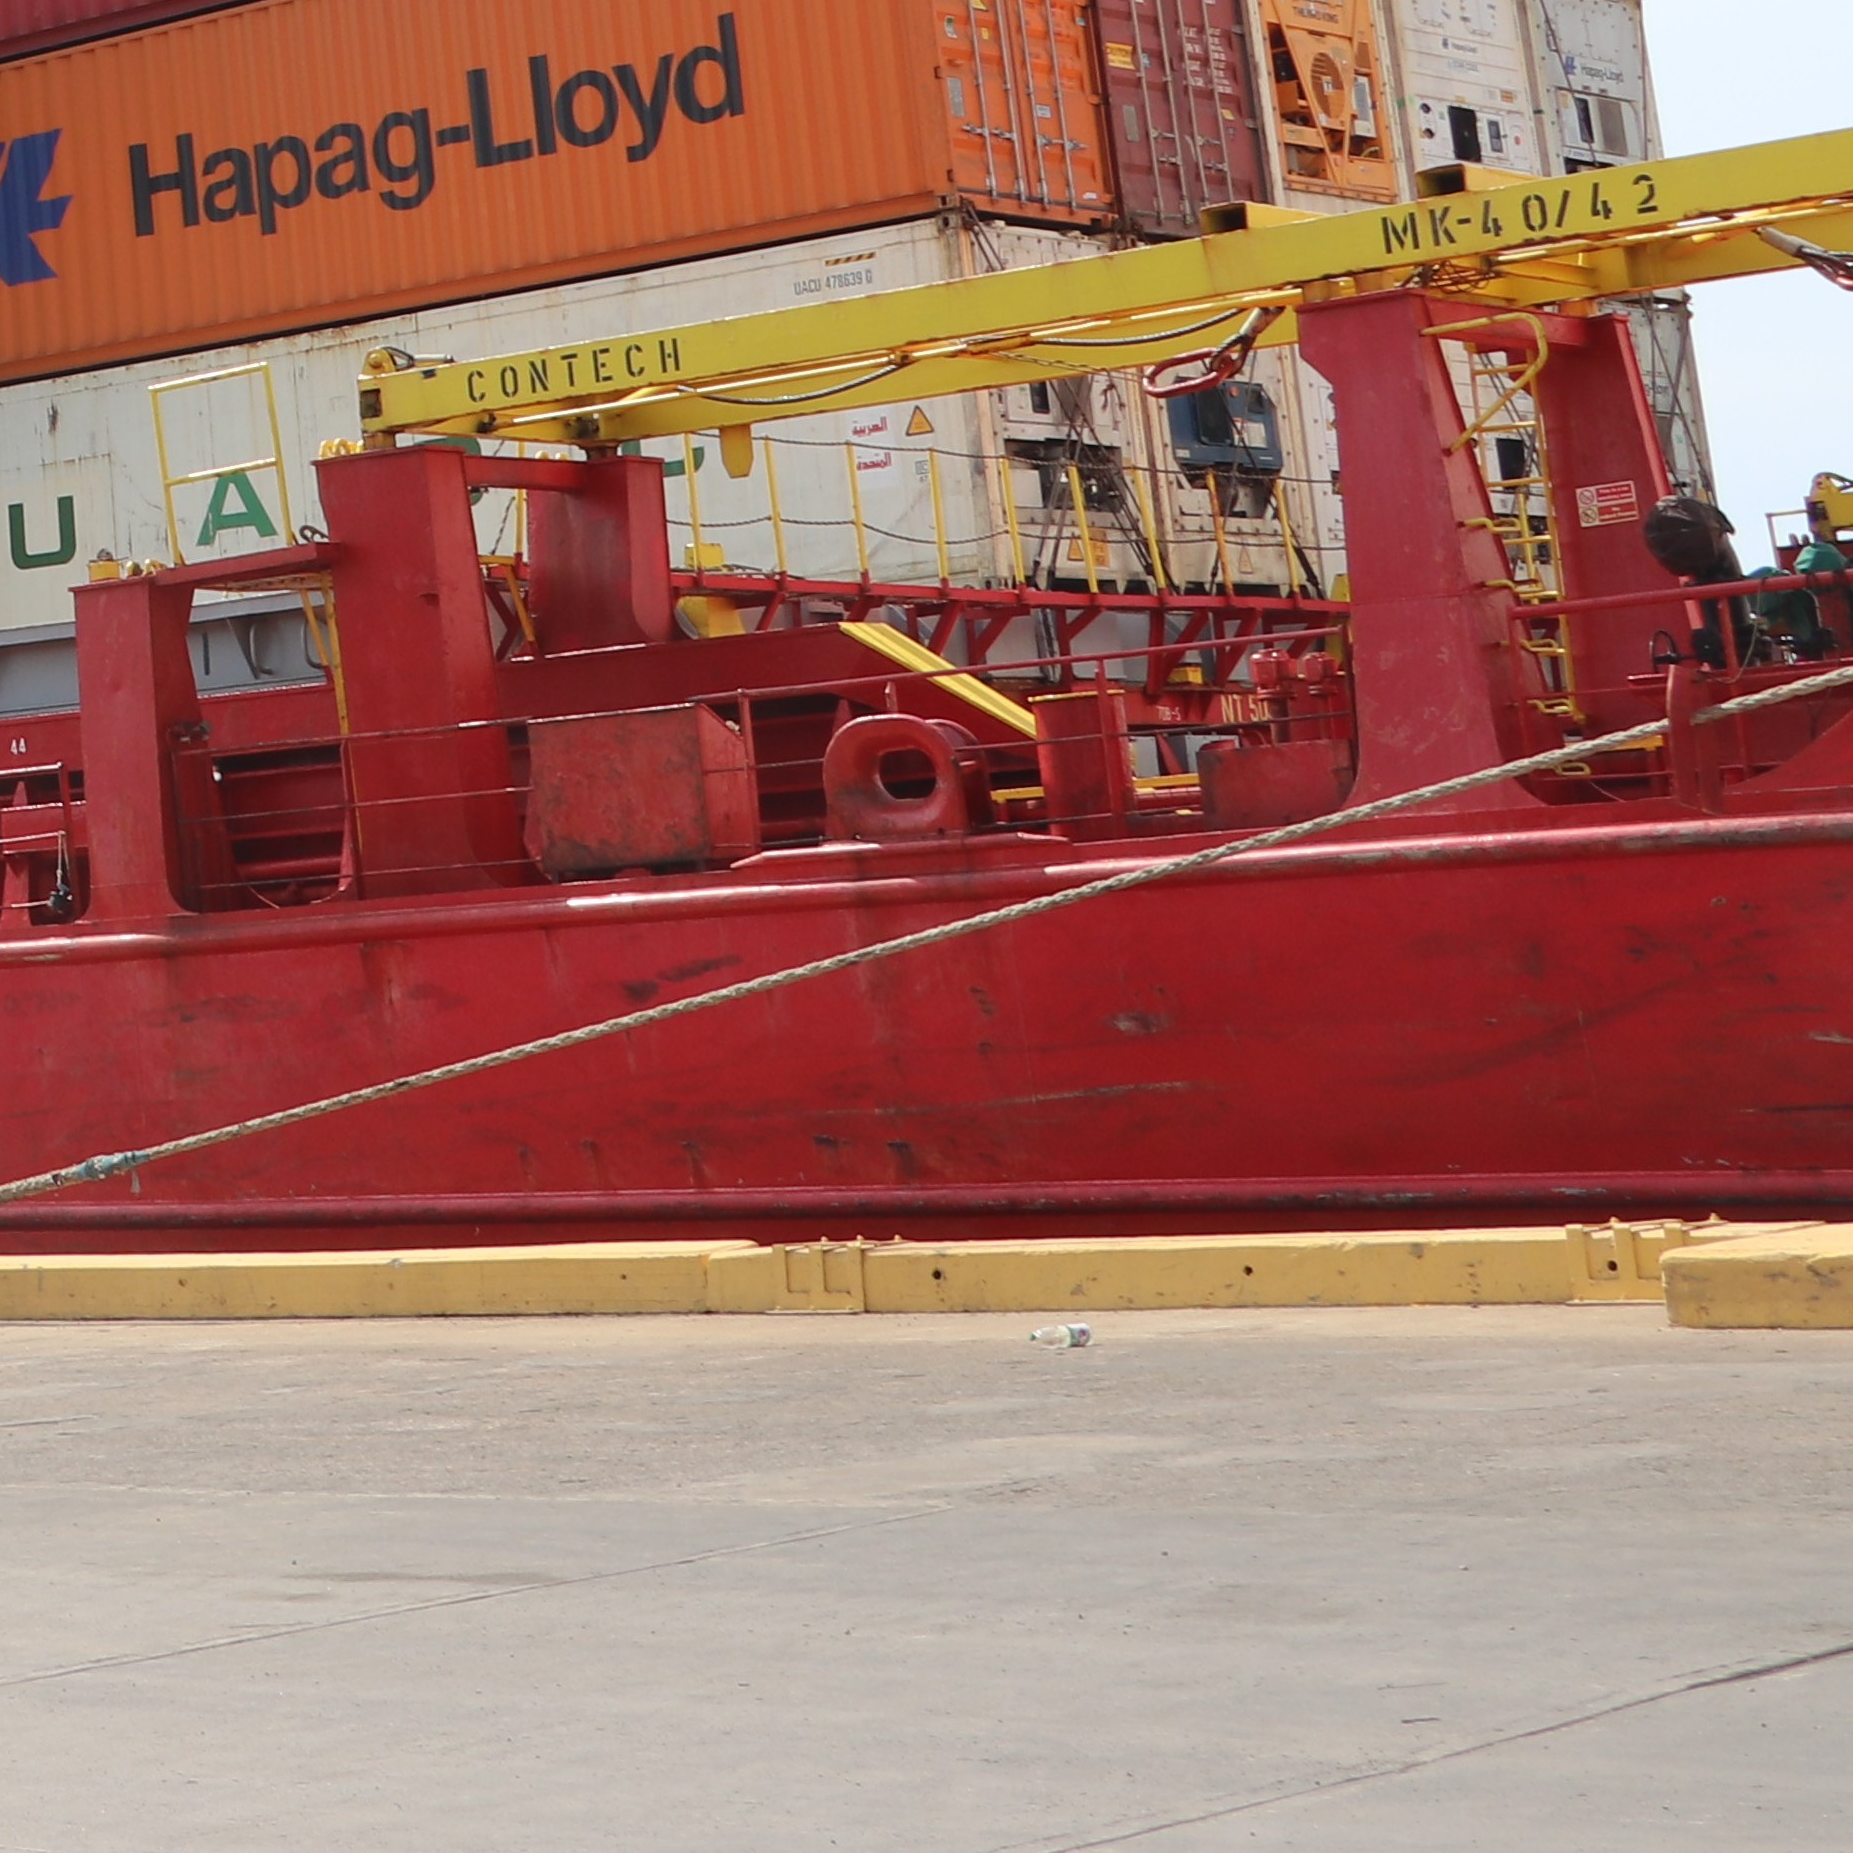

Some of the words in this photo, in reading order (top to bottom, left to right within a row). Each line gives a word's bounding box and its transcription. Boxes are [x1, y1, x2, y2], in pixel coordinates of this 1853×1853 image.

[131, 12, 745, 236] Hapag-Lloyd
[793, 276, 822, 296] UACU
[824, 271, 863, 292] 478639
[466, 337, 683, 404] CONTECH
[1220, 693, 1244, 724] NT
[10, 737, 27, 755] 44
